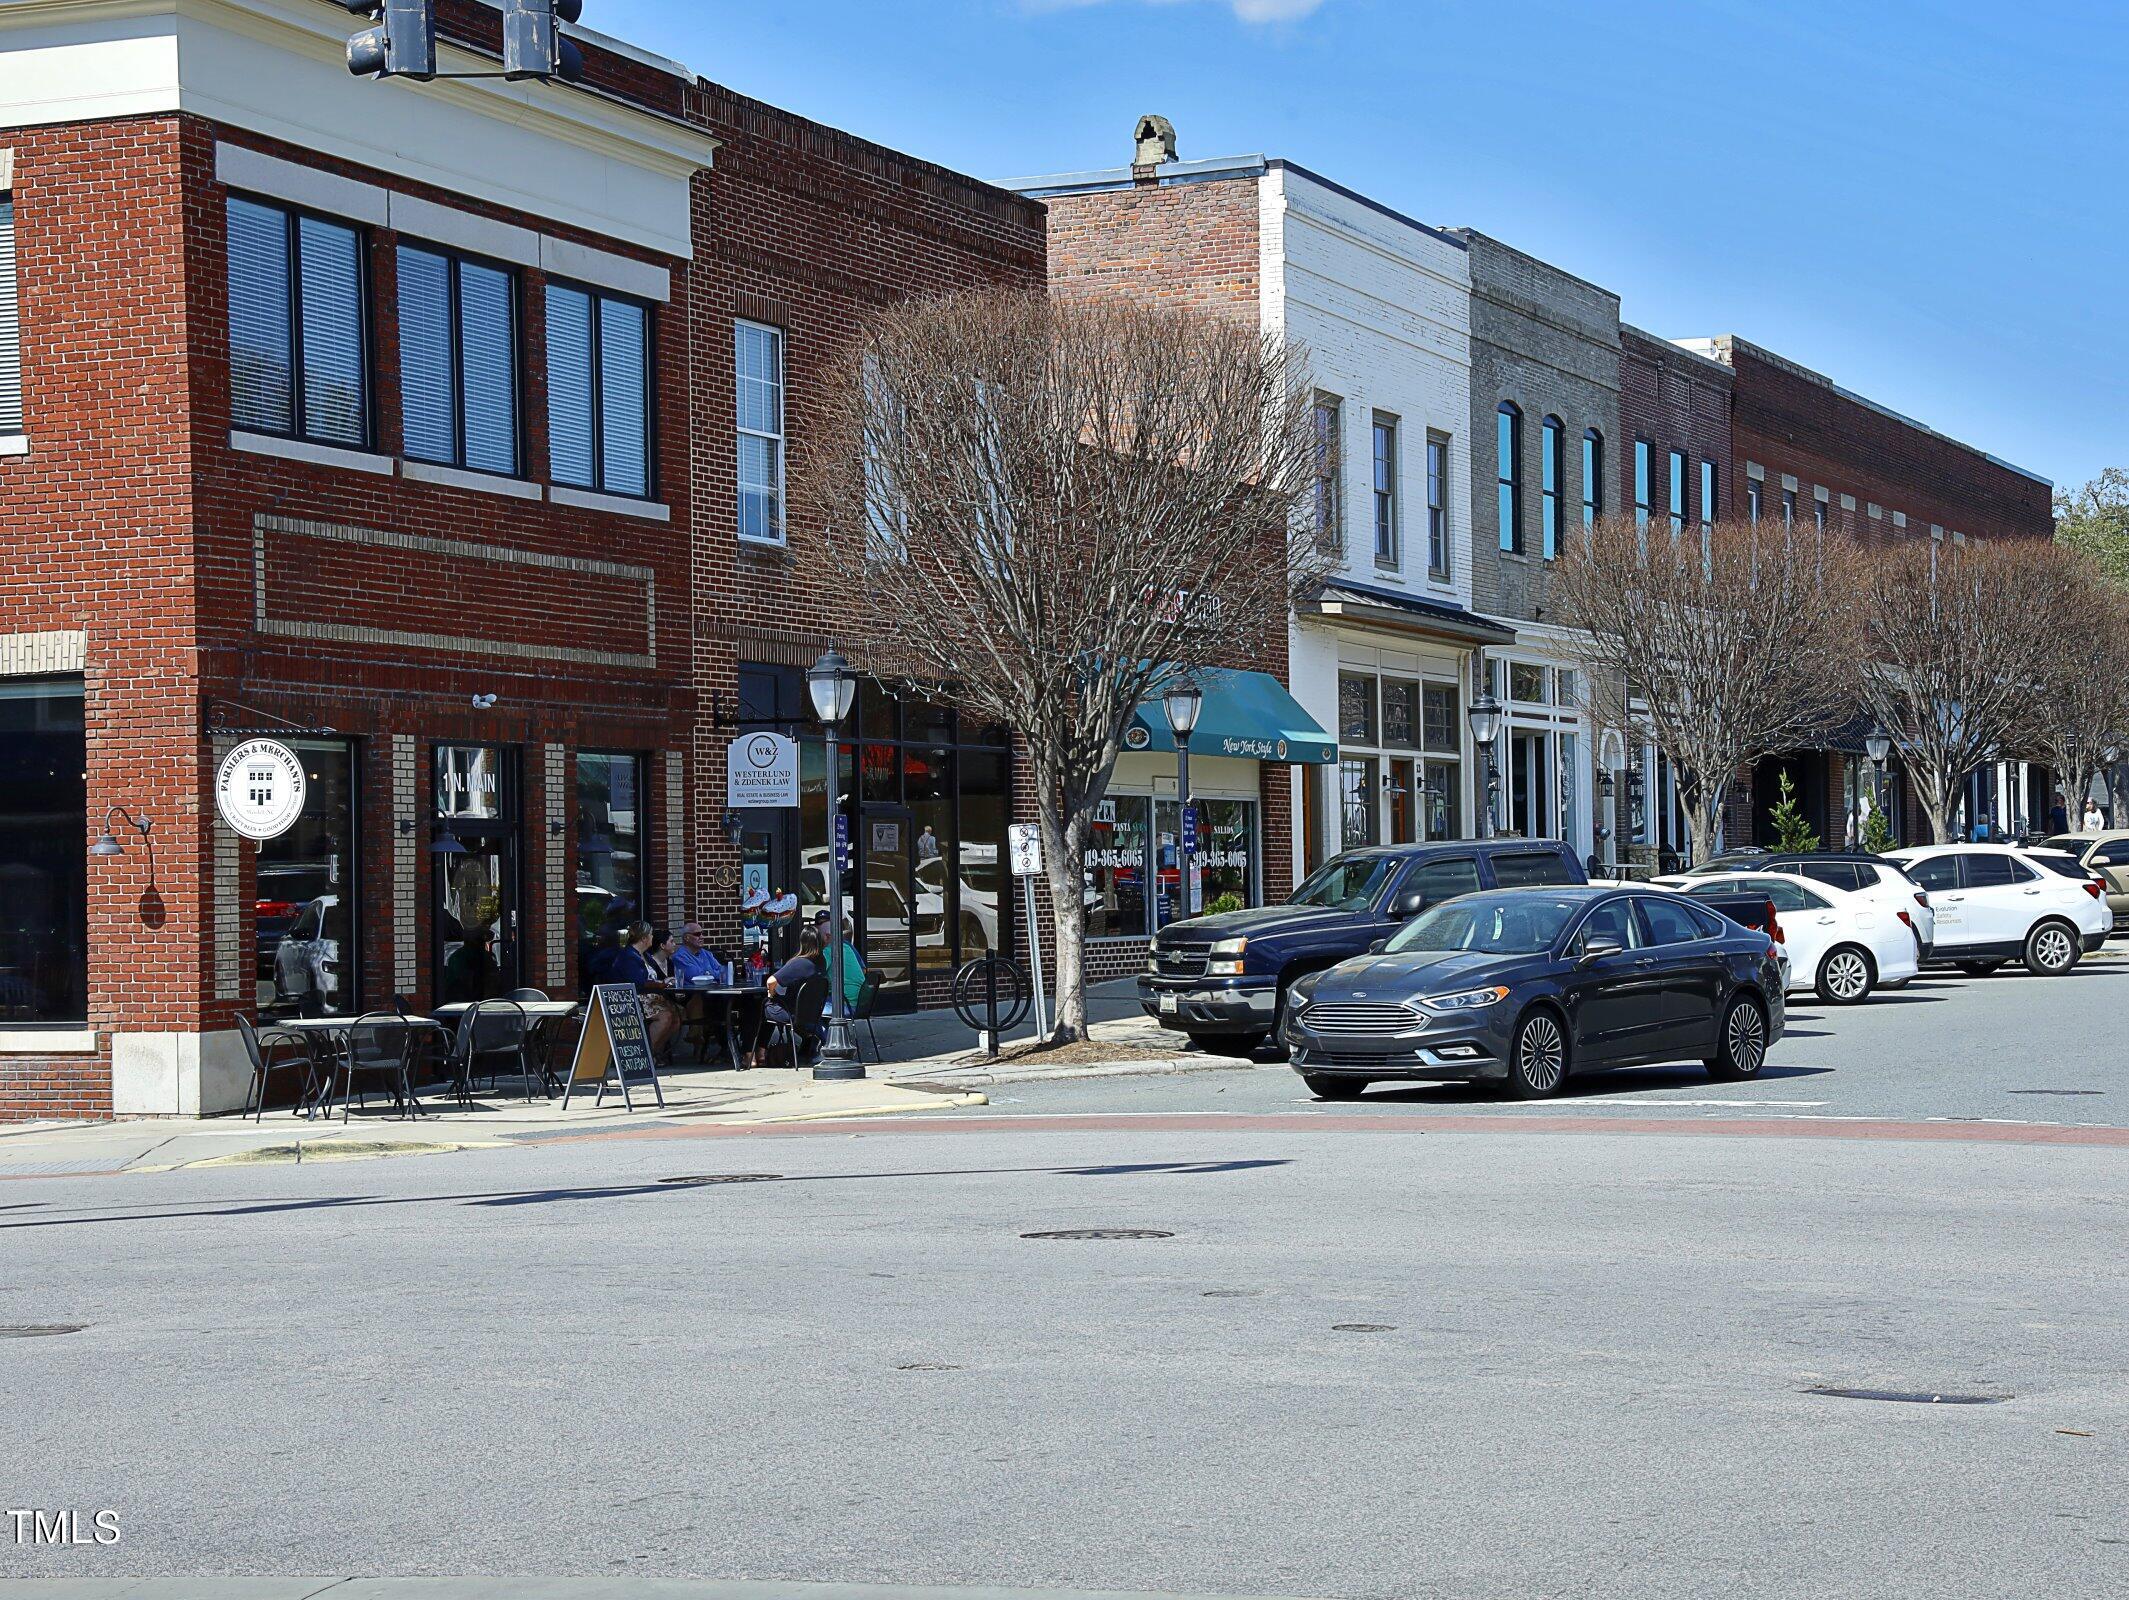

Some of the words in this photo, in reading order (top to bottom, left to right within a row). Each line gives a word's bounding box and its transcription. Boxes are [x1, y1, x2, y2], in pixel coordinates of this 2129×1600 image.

[755, 747, 779, 756] W&Z
[1223, 737, 1240, 753] New
[1240, 739, 1257, 755] York
[1256, 741, 1272, 759] Style
[221, 747, 250, 791] FARMERS
[251, 744, 258, 753] &
[260, 743, 301, 793] MERCHANTS
[734, 770, 791, 778] WESTERLUND
[466, 772, 496, 793] MAIN
[734, 778, 740, 786] &
[741, 778, 772, 786] ZDENEK
[773, 778, 790, 786] LAW
[1113, 822, 1130, 831] PASTA
[1213, 825, 1234, 834] SALADS
[1192, 850, 1247, 867] 919-365-6065
[723, 868, 729, 885] 3
